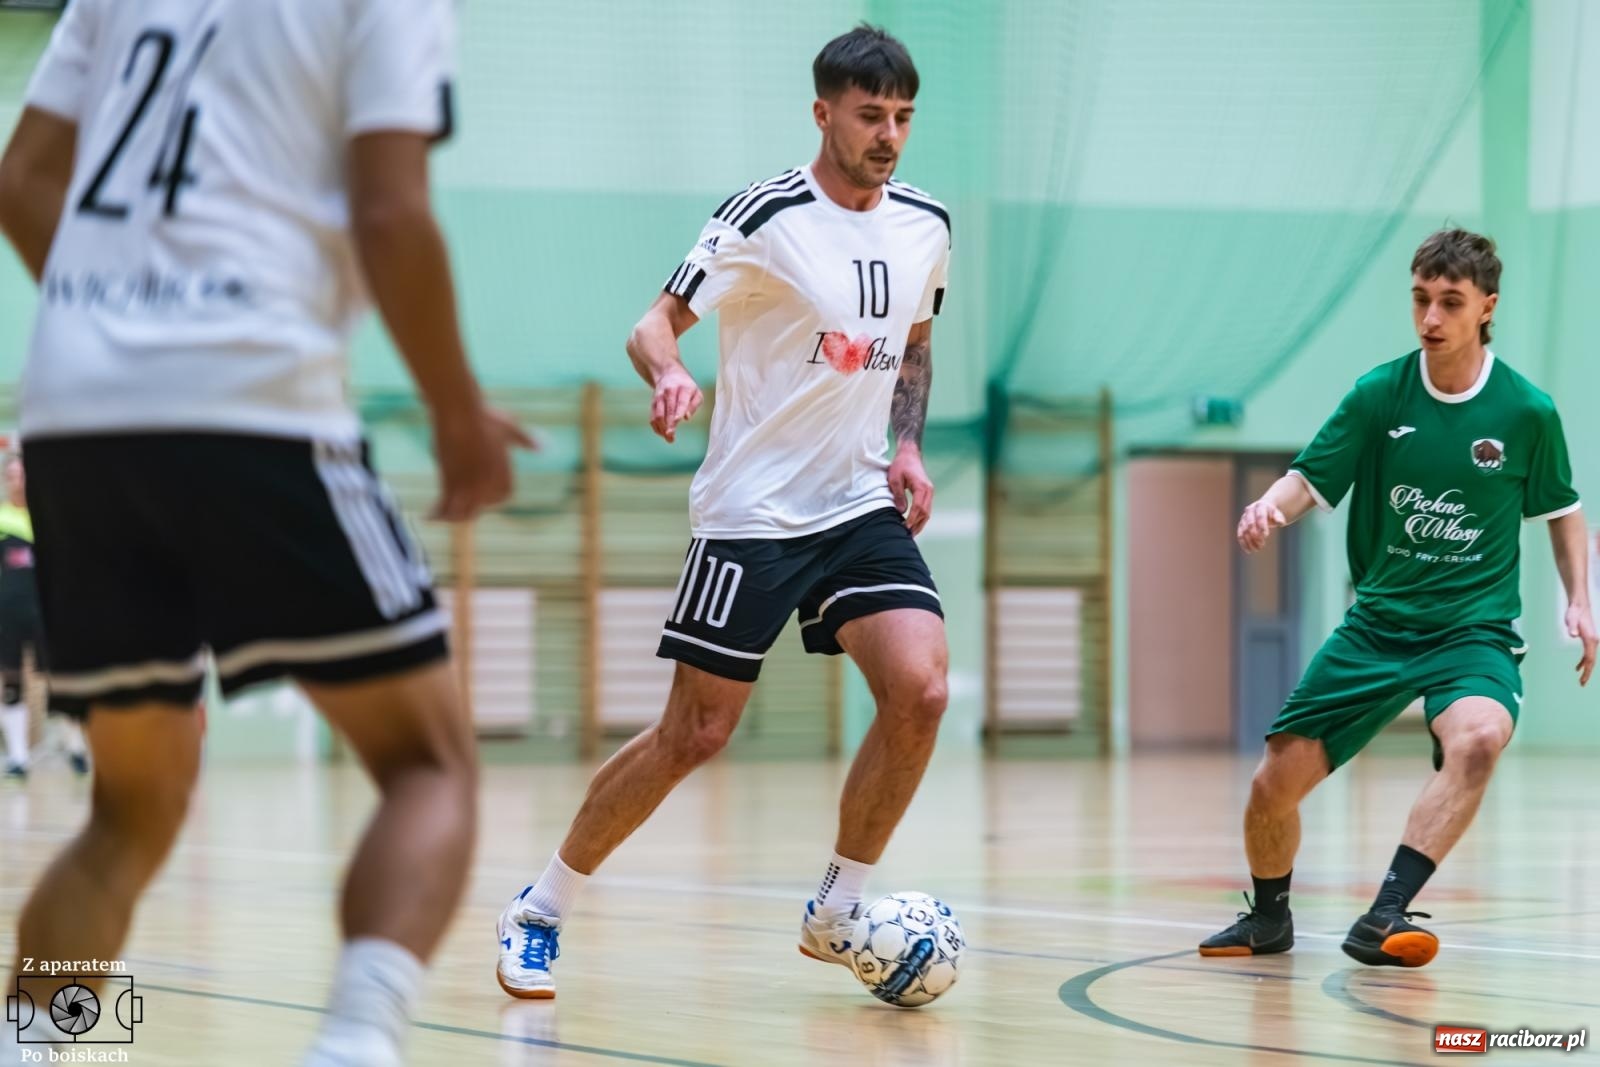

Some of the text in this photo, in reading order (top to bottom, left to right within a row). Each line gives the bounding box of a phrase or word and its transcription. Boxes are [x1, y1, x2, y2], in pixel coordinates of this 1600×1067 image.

[76, 26, 218, 218] 24
[852, 259, 890, 319] 10
[1389, 484, 1466, 515] Piękne
[1404, 513, 1485, 553] Włosy
[692, 555, 744, 629] 10
